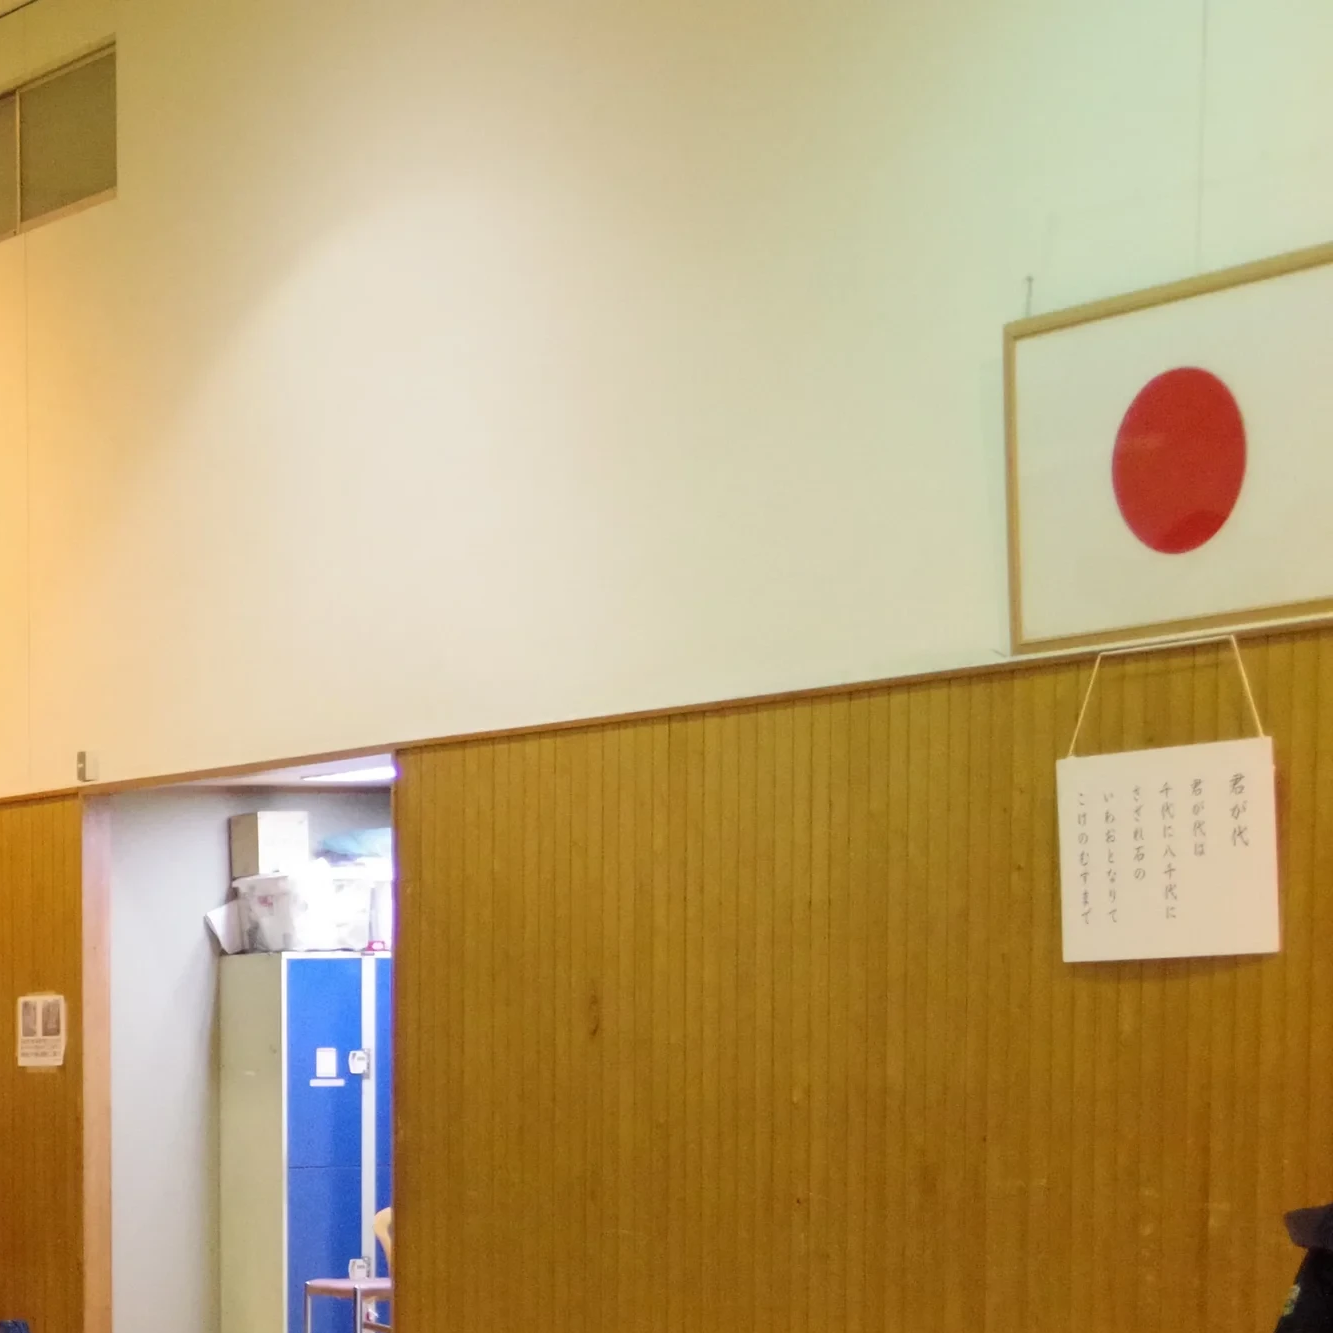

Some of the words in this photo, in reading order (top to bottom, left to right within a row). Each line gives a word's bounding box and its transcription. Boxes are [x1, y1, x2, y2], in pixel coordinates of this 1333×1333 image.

[1190, 778, 1207, 857] 君が代は
[1229, 772, 1249, 848] 君が代
[1158, 781, 1178, 920] 千代に八千代に
